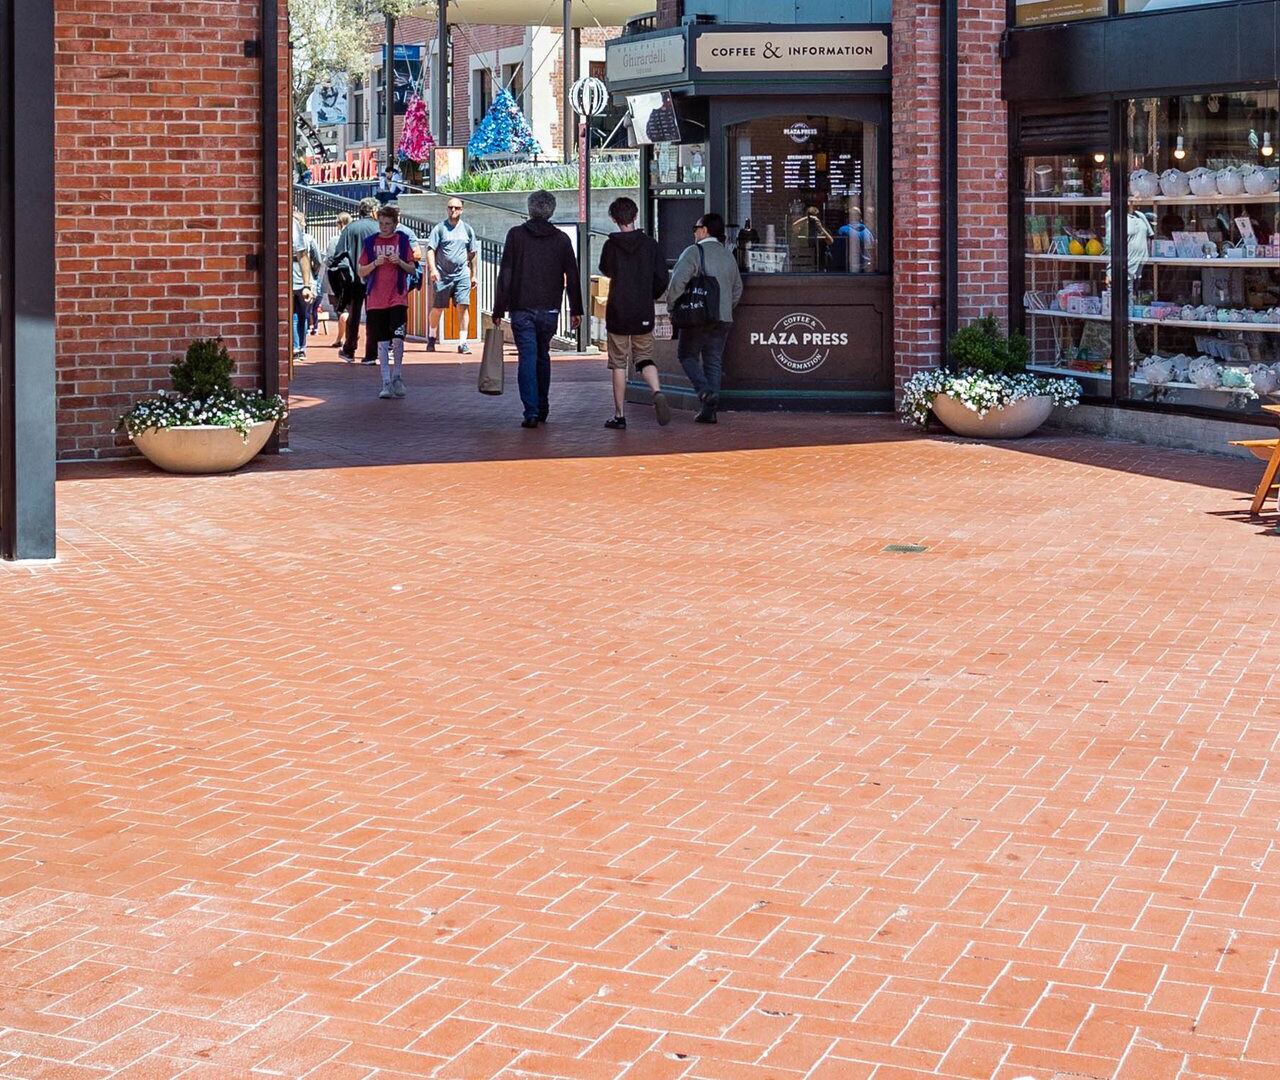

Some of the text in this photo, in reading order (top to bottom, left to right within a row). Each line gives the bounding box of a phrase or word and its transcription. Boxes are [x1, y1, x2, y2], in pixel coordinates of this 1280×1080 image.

[623, 48, 667, 68] Ghirardelli
[711, 41, 874, 60] COFFEE & INFORMATION
[782, 315, 810, 327] COFFEE
[750, 332, 849, 346] PLAZA PRESS
[776, 353, 823, 370] INFORMATION
